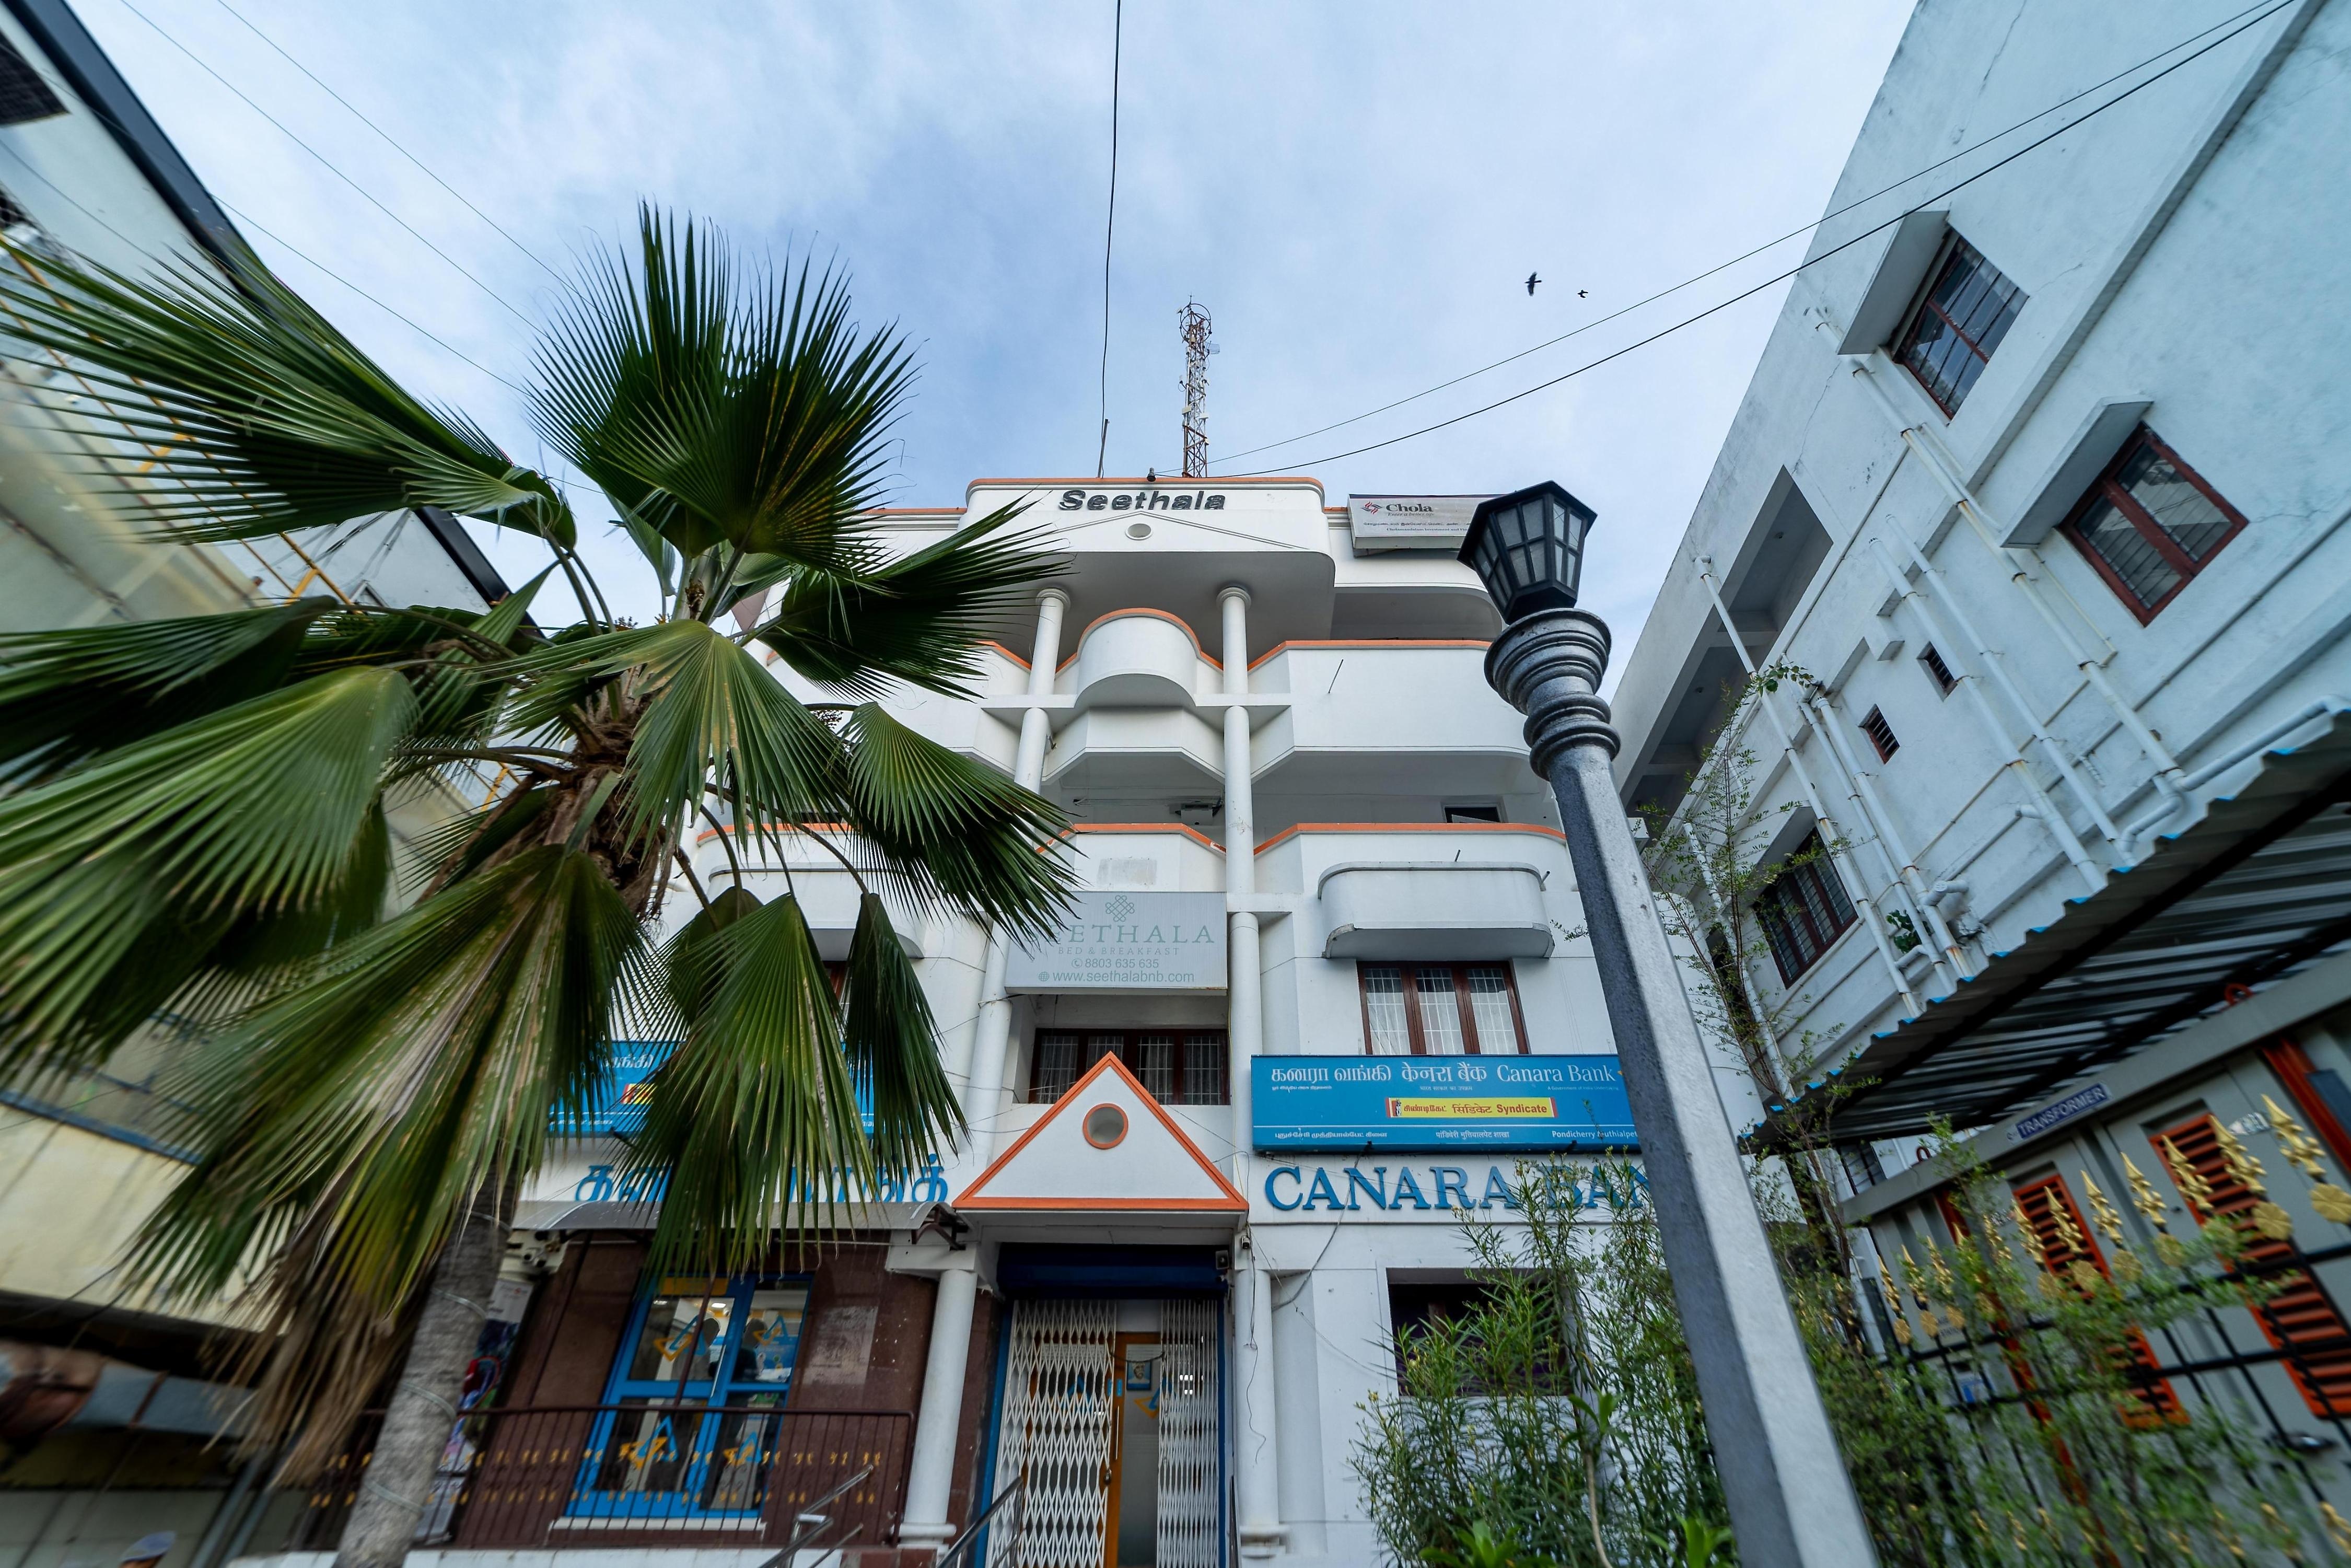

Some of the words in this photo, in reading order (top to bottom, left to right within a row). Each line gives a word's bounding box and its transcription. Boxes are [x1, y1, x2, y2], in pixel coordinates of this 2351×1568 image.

[1058, 490, 1226, 510] Seethala
[1386, 503, 1434, 512] Chola
[1058, 947, 1083, 955] BED
[1088, 947, 1096, 955] &
[1101, 947, 1180, 956] BREAKFAST
[1085, 959, 1112, 968] 8803
[1115, 959, 1136, 968] 635
[1138, 959, 1159, 969] 635
[1052, 970, 1195, 983] www.seethalabnb.com
[1271, 1068, 1329, 1084] கனரா
[1401, 1062, 1453, 1082] केनरा
[1457, 1062, 1487, 1082] बैंक
[1497, 1064, 1564, 1082] Canara
[1567, 1064, 1616, 1082] Bank
[1452, 1103, 1493, 1114] सिंडिकेट
[1496, 1104, 1547, 1115] Syndicate
[2018, 1086, 2105, 1135] TRANSFORMER
[1552, 1130, 1595, 1139] Pondicherry
[1265, 1166, 1523, 1211] CANARA
[1543, 1165, 1650, 1209] BAN
